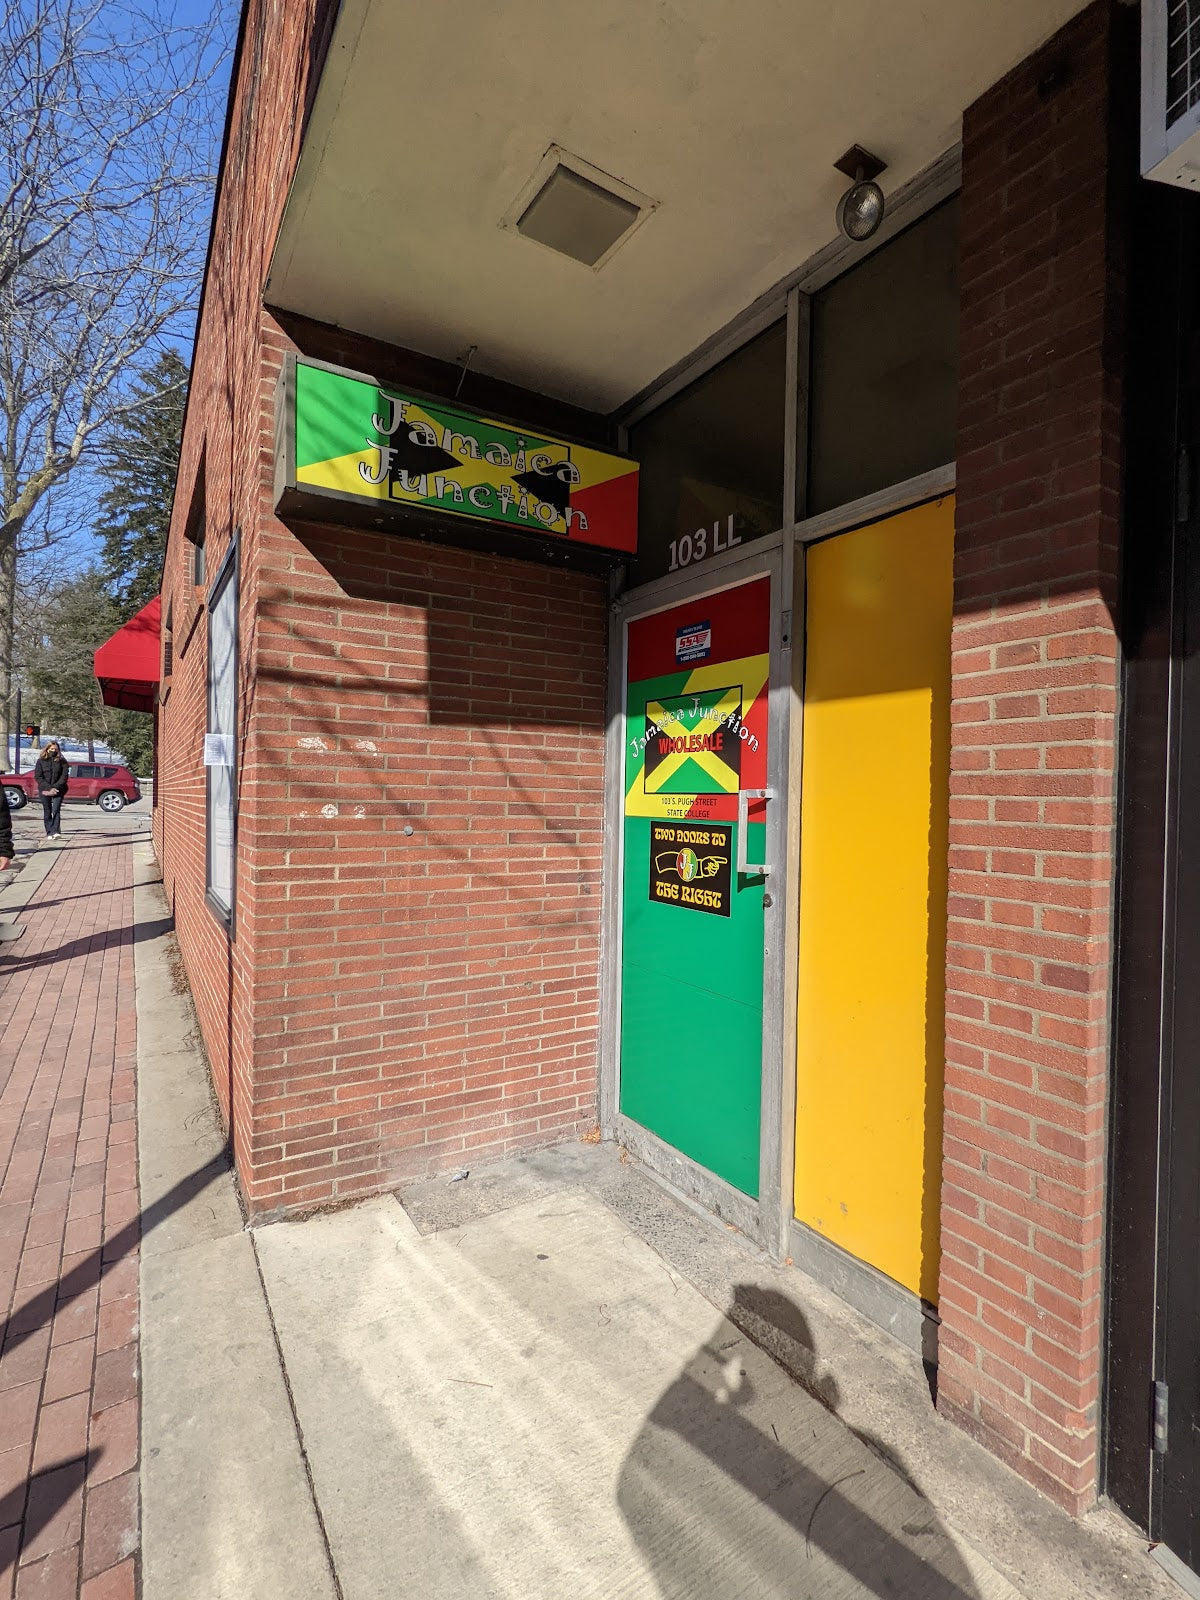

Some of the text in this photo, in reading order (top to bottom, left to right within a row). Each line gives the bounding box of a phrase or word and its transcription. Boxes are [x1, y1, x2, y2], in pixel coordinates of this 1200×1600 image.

[371, 389, 581, 484] Jamaica
[359, 437, 589, 530] Junction
[669, 514, 742, 572] 103 LL
[629, 697, 759, 758] Jamaica Junction
[658, 732, 724, 755] WHOLESALE
[662, 797, 671, 805] 103
[678, 798, 694, 806] PUGH
[695, 798, 718, 807] STREET
[667, 809, 710, 818] STATE COLLEGE
[655, 828, 726, 847] TWO DOORS TO
